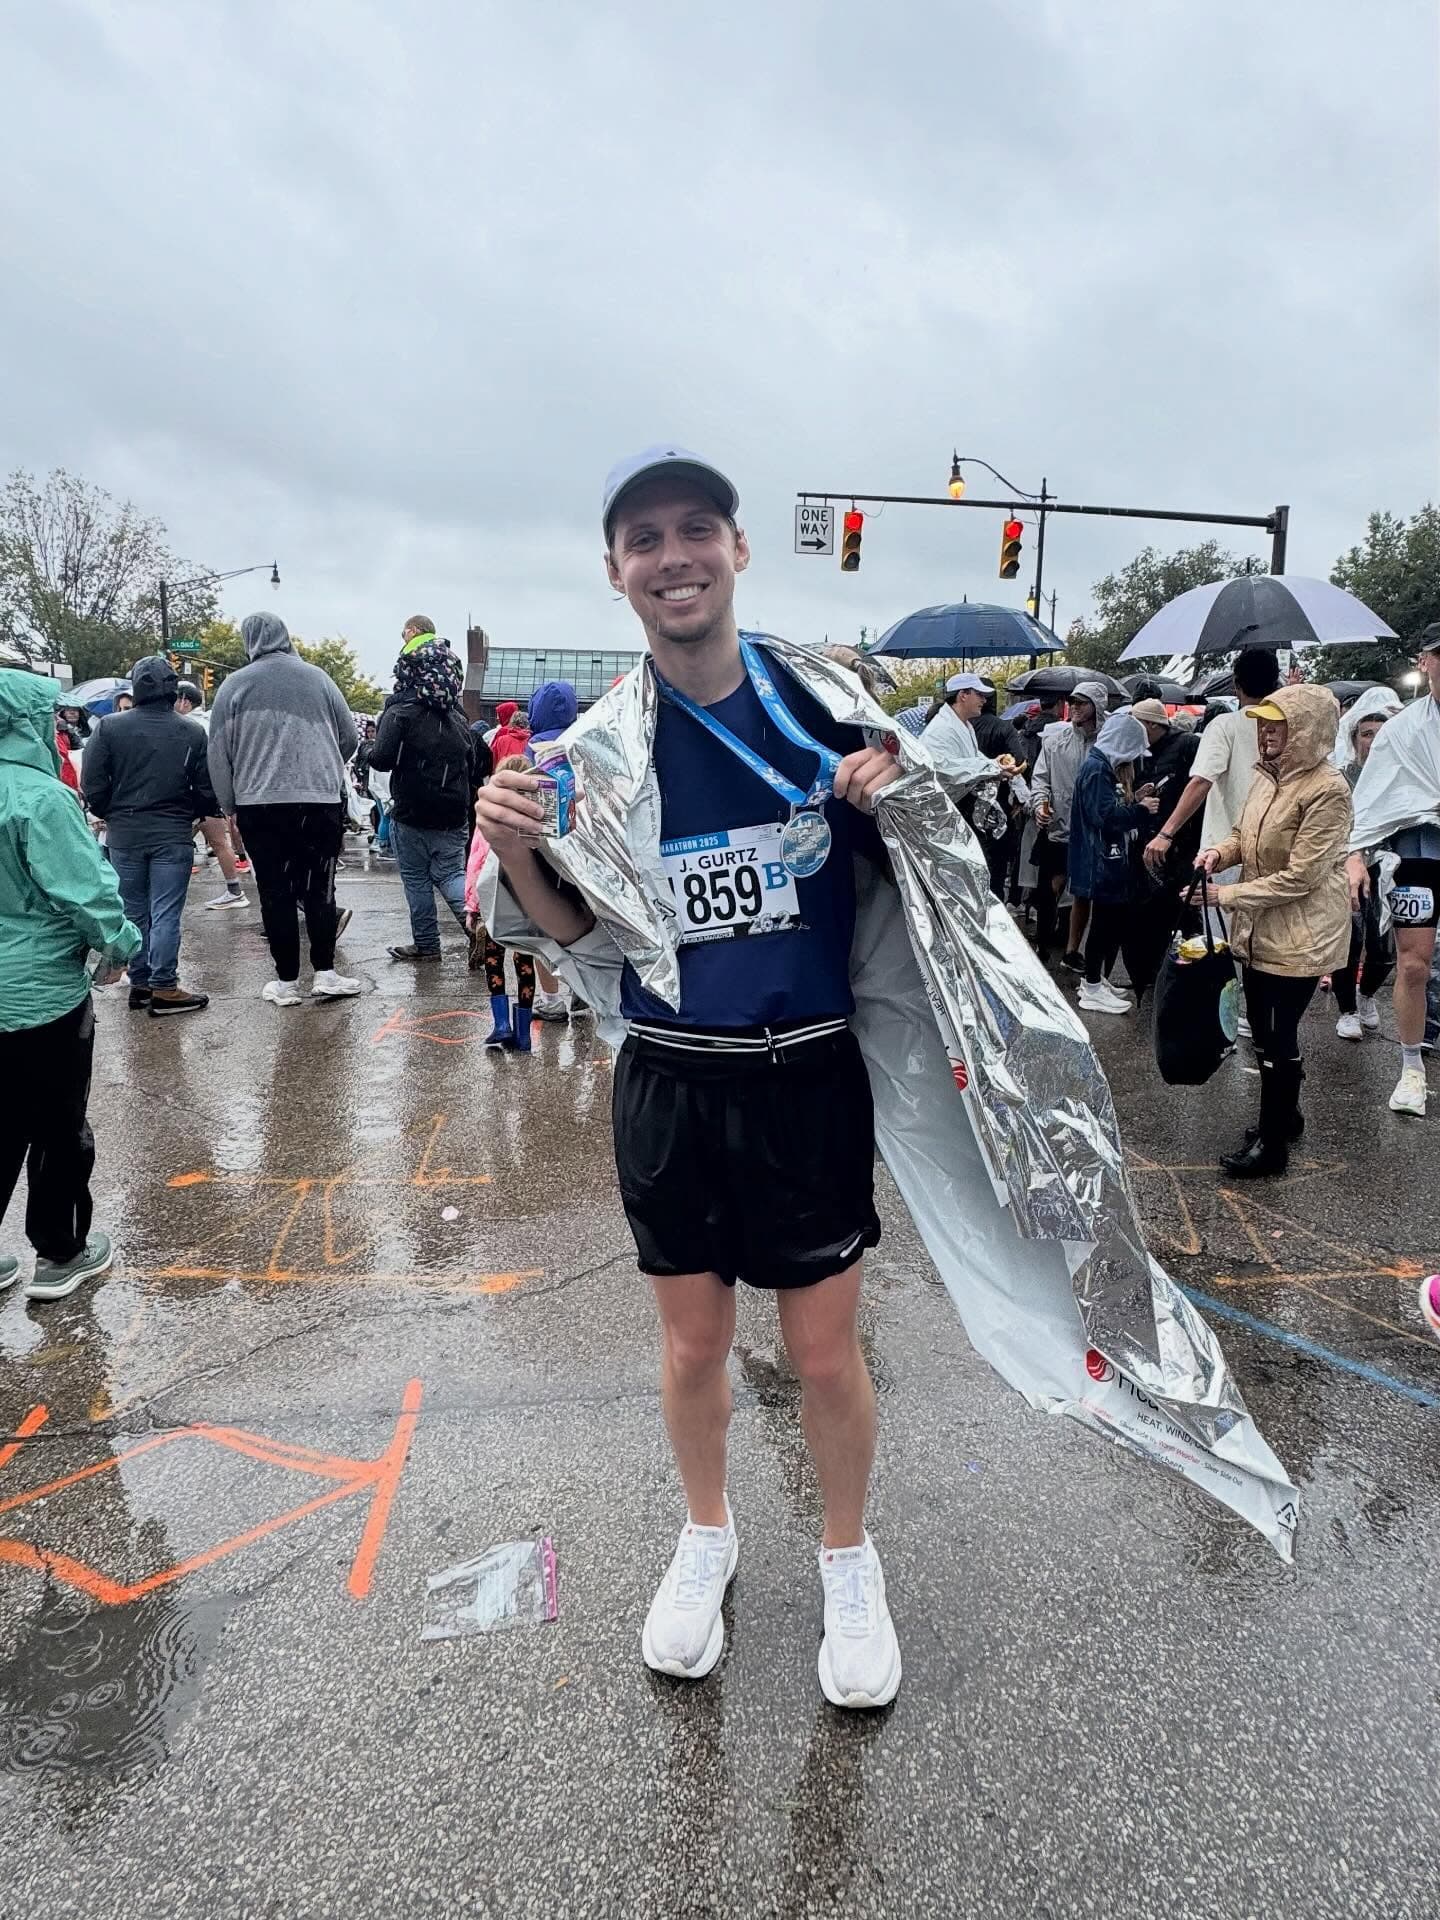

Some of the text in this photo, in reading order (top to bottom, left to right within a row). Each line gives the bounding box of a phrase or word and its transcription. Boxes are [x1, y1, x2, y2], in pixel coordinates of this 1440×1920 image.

[801, 508, 828, 522] ONE
[800, 523, 828, 536] WAY
[699, 835, 719, 848] 2025
[680, 847, 758, 873] J. GURTZ
